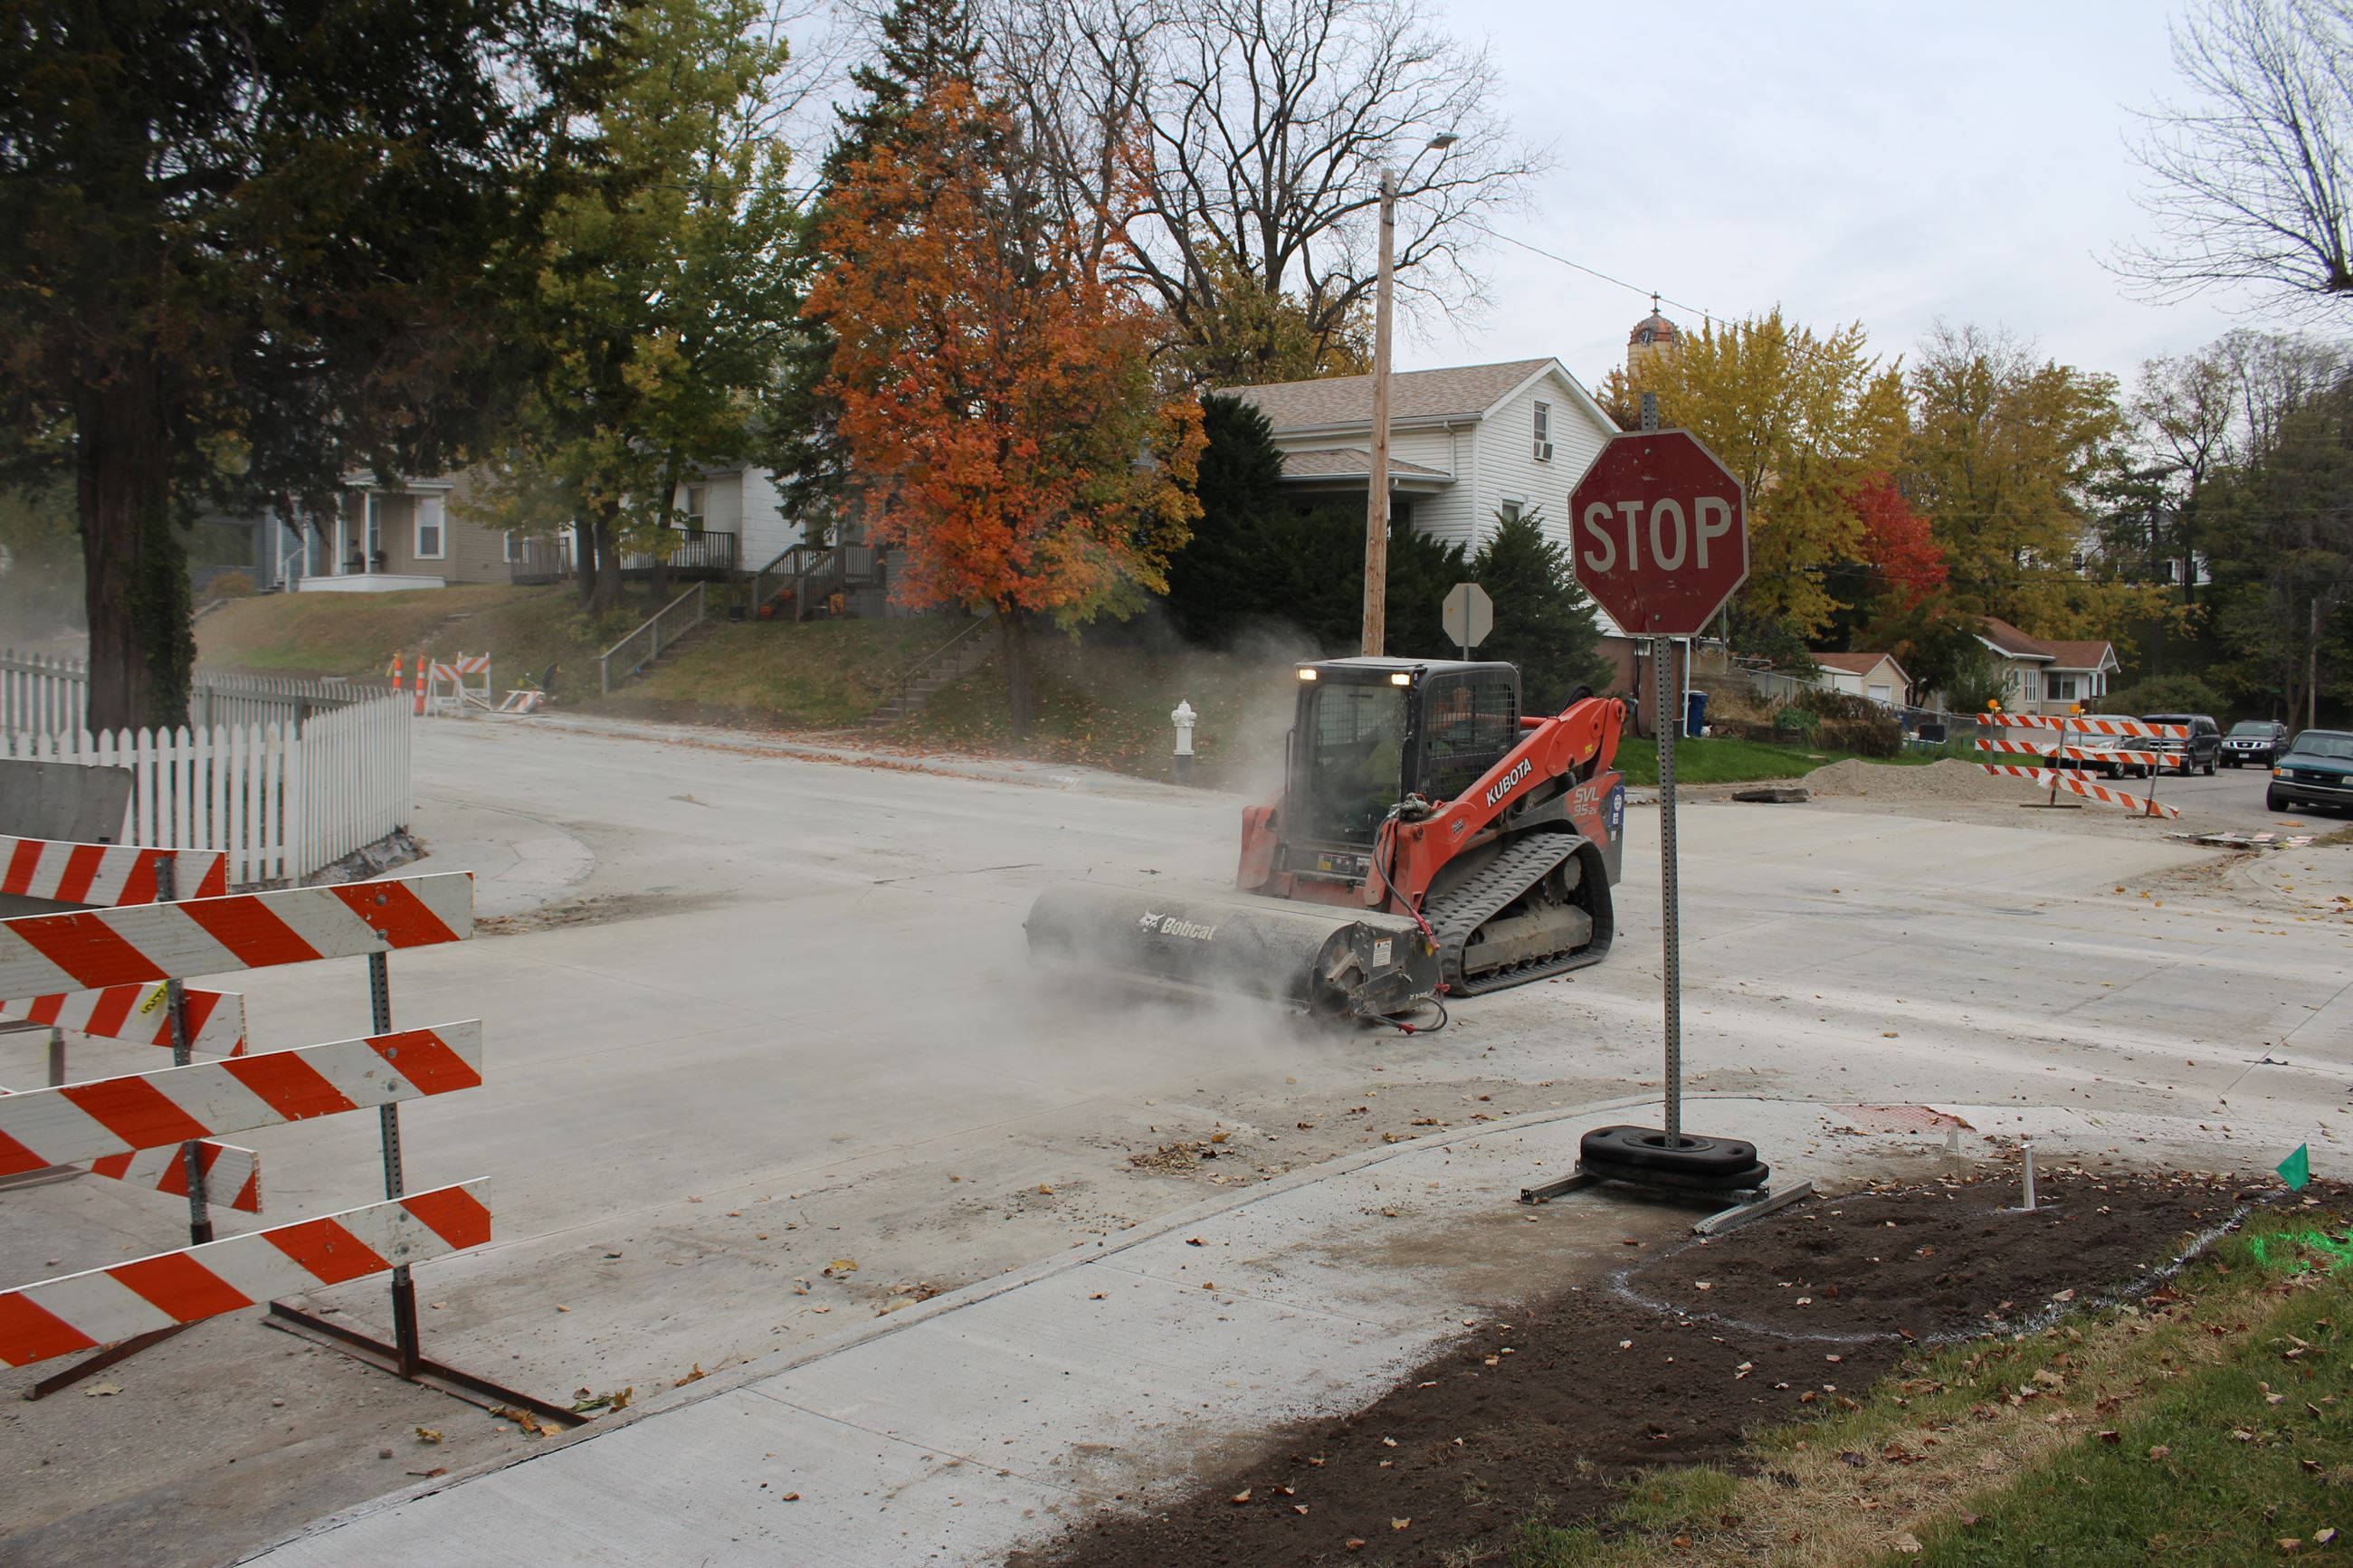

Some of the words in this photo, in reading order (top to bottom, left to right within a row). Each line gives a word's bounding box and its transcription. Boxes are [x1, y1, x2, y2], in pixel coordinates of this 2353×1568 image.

[1584, 496, 1732, 573] STOP
[1486, 757, 1533, 807] KUBOTA
[1574, 786, 1600, 803] SVL
[1159, 917, 1217, 941] Bobcat
